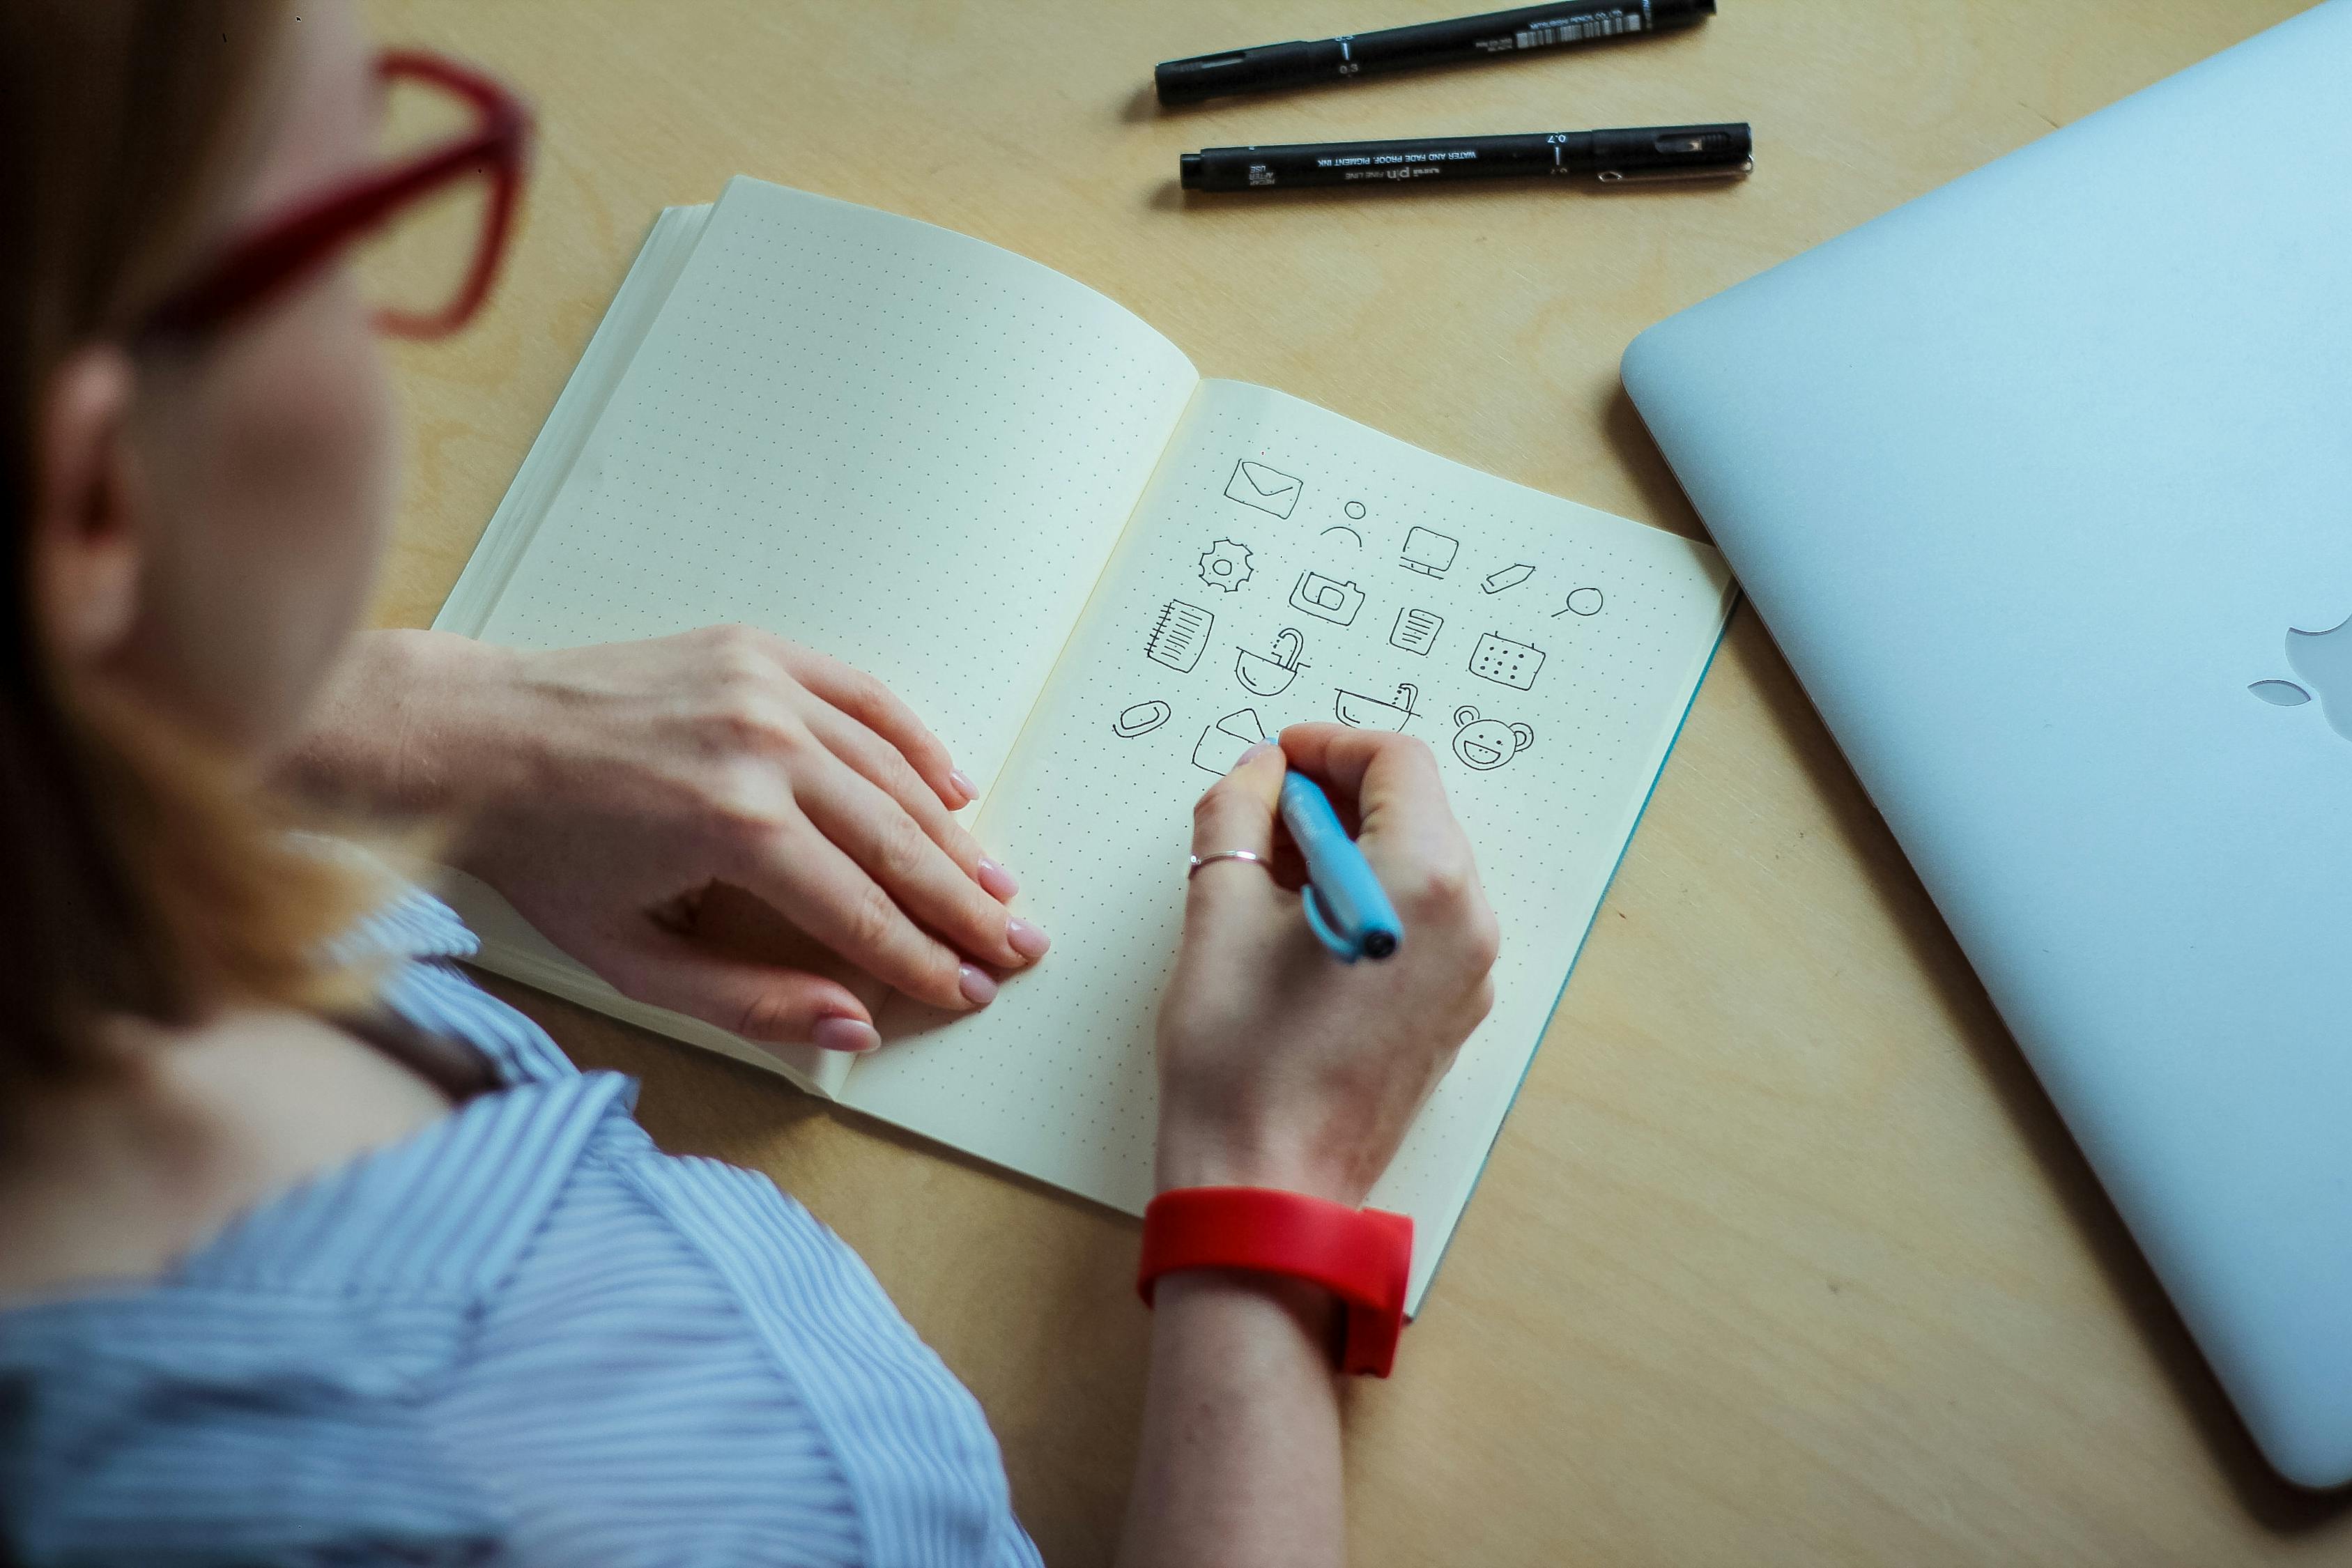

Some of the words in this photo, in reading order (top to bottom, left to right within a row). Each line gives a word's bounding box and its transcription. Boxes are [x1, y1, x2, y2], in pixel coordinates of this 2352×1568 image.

[1547, 134, 1566, 144] 0.7
[1448, 151, 1476, 160] WATER
[1334, 157, 1370, 167] PIGMENT
[1387, 167, 1410, 181] pin
